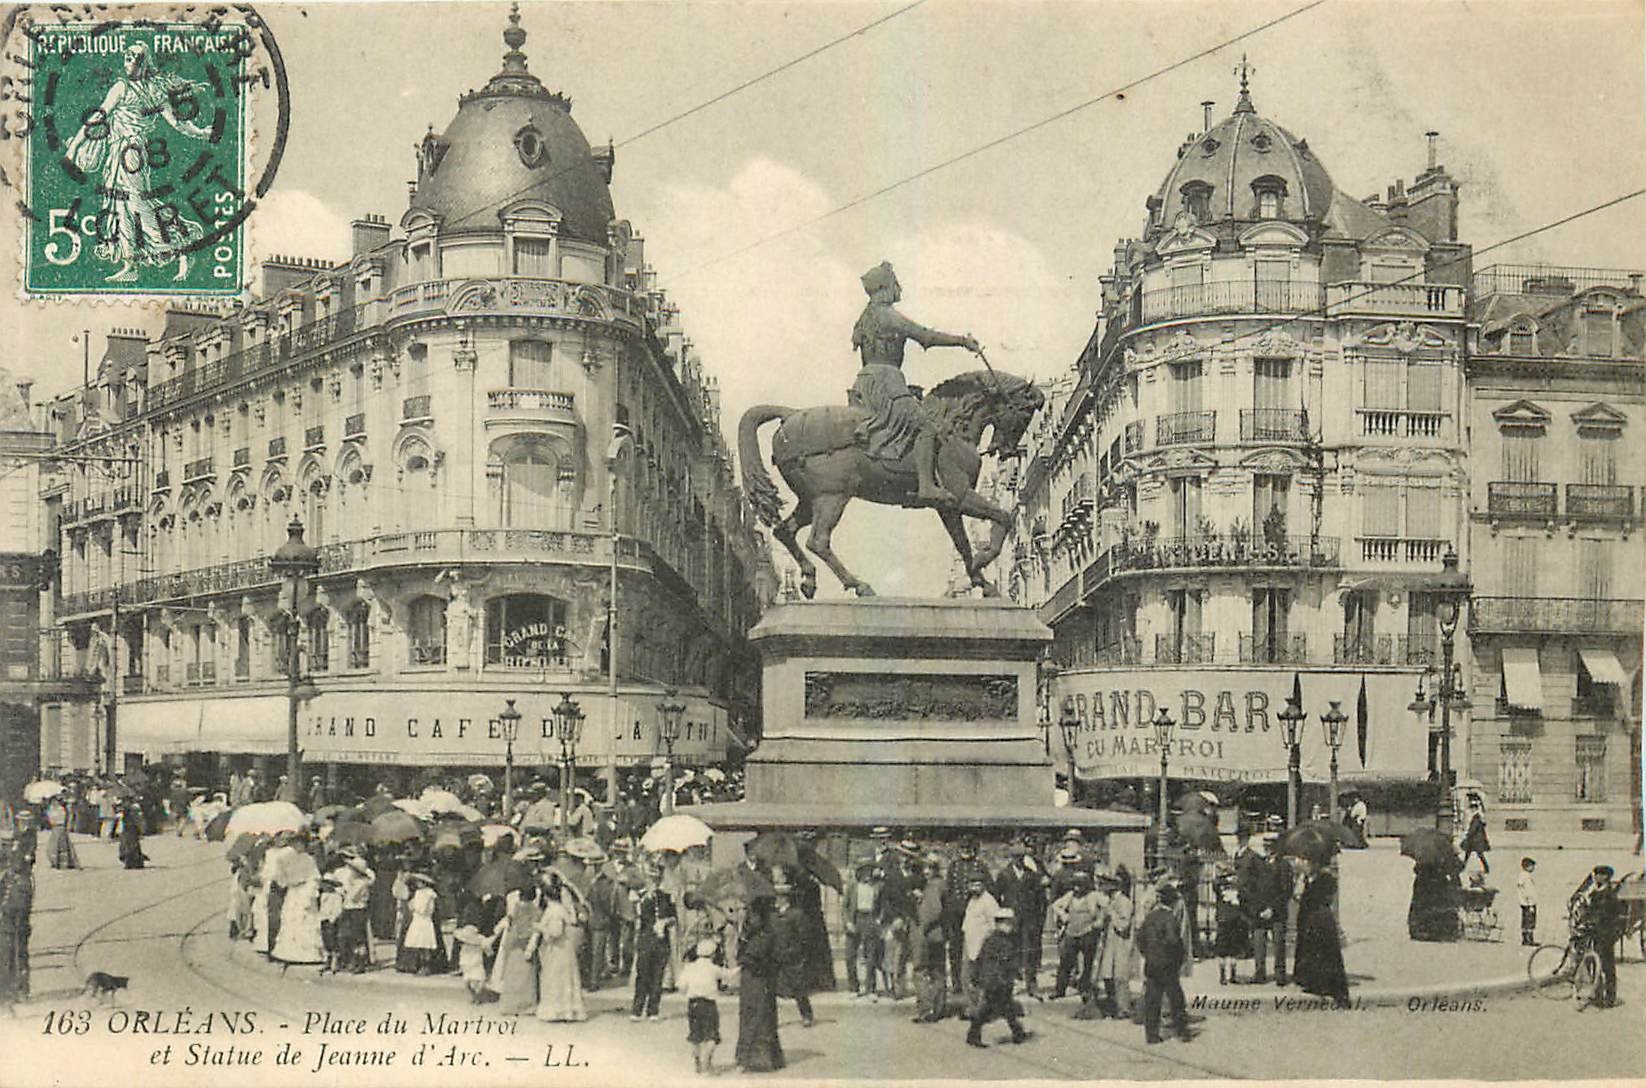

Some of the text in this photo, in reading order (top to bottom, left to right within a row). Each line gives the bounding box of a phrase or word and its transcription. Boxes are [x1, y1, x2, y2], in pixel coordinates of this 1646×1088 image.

[503, 622, 548, 649] GRAND
[1180, 689, 1270, 733] BAR
[407, 719, 501, 738] CAFE
